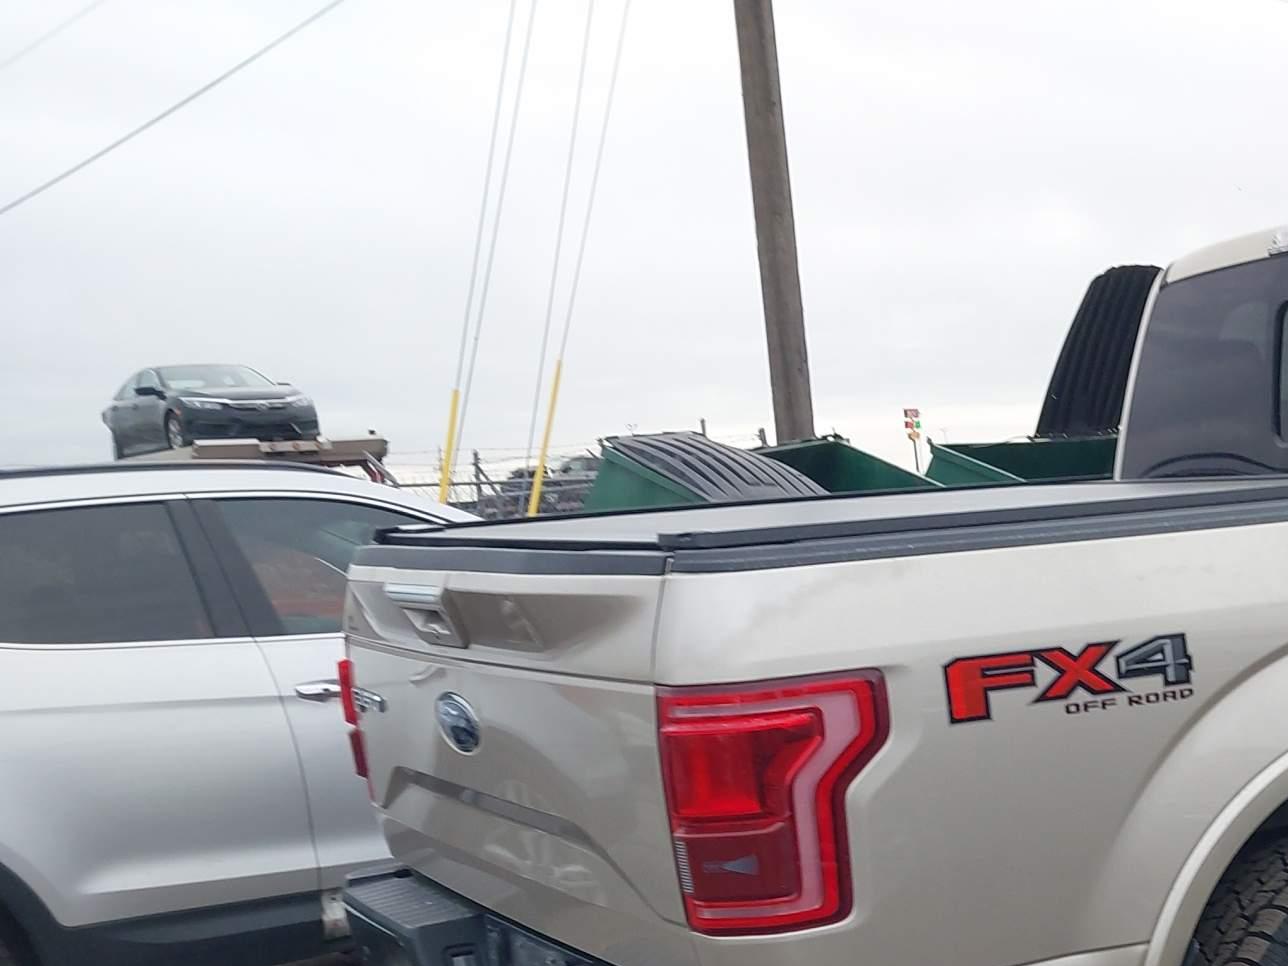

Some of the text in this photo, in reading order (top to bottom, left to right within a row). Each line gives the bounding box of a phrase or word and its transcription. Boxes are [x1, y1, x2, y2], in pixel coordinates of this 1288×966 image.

[943, 633, 1193, 725] FX4
[1065, 688, 1195, 715] OFF ROAD
